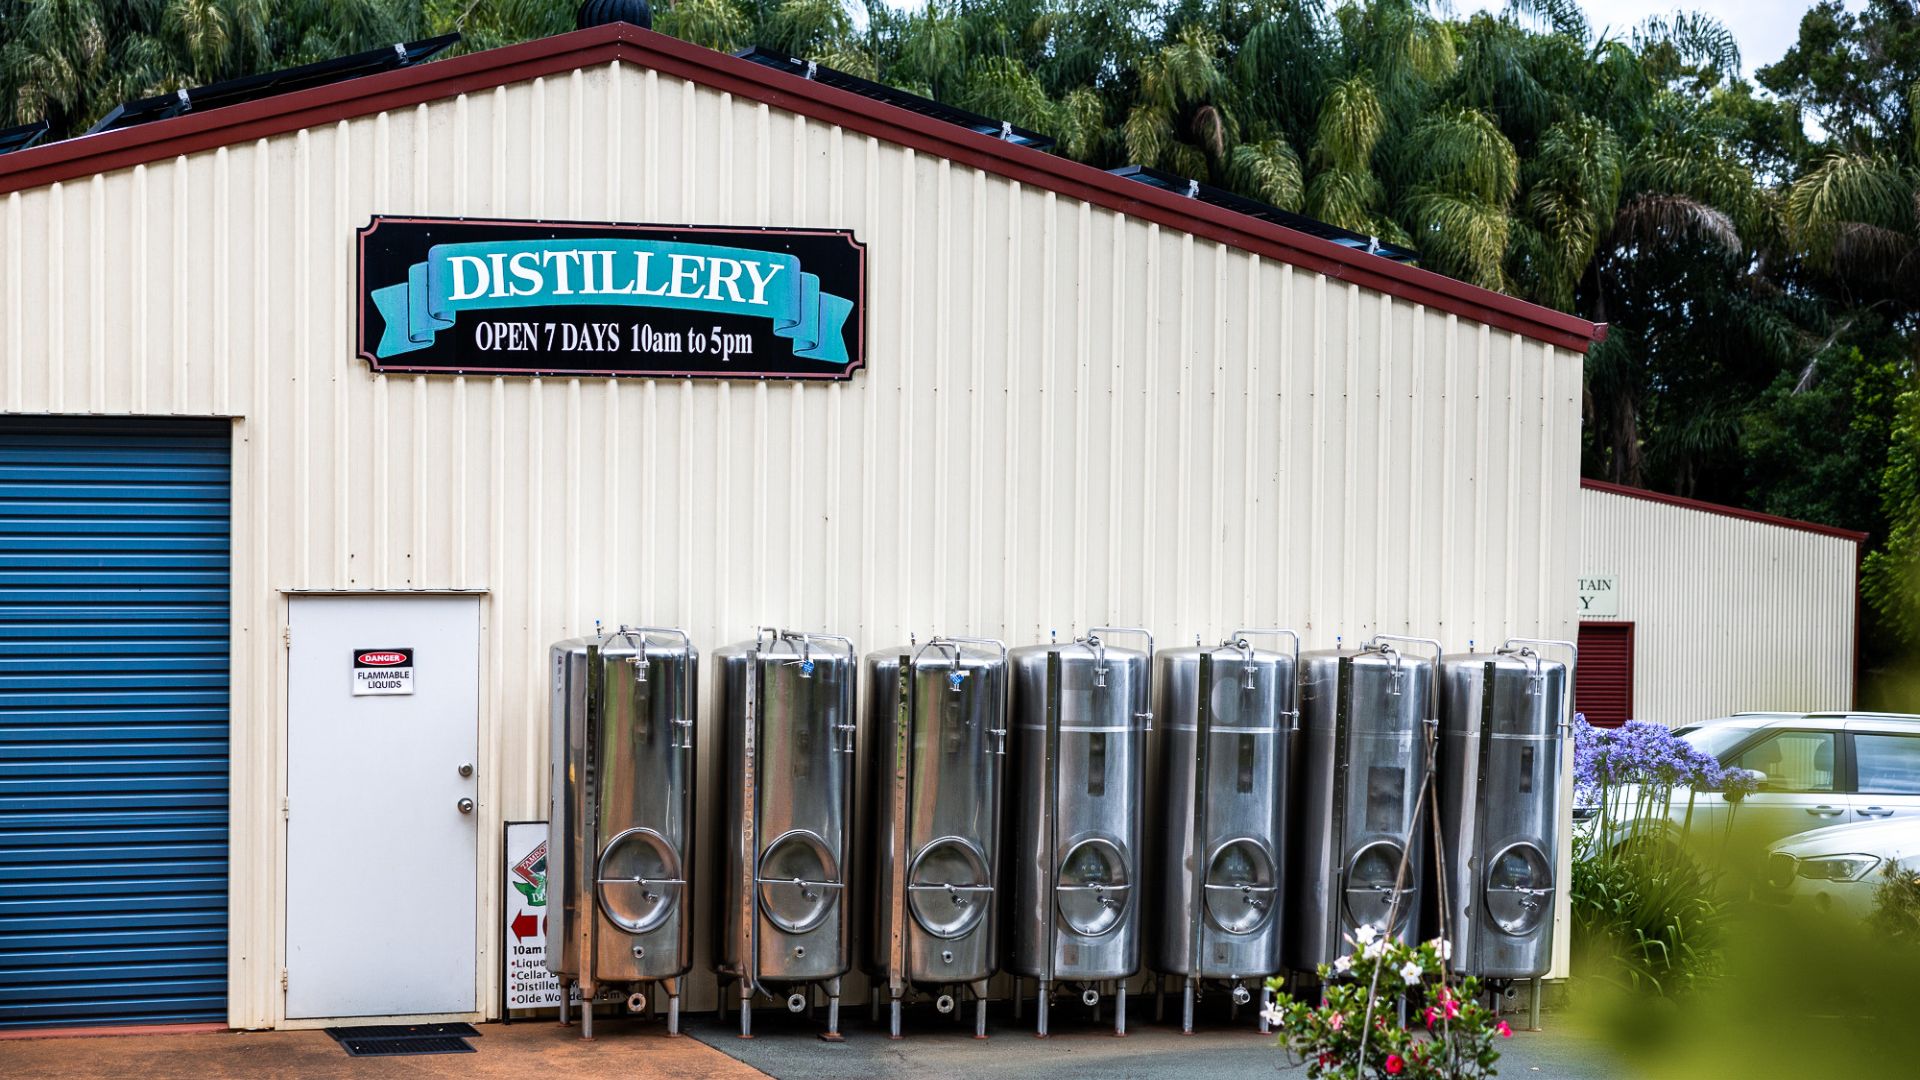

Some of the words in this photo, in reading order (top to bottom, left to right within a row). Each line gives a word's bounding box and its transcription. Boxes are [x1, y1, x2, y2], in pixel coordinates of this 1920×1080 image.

[447, 249, 785, 305] DISTILLERY
[475, 321, 539, 351] OPEN
[544, 322, 556, 352] 7
[561, 322, 620, 352] DAYS
[630, 323, 682, 353] 10am
[687, 326, 706, 354] to
[710, 326, 753, 361] 5pm
[1577, 579, 1612, 591] TAIN
[1580, 596, 1594, 609] Y
[365, 654, 400, 662] DANGER
[357, 671, 410, 680] FLAMMABLE
[368, 680, 402, 689] LIQUIDS
[520, 844, 547, 870] TAMBO
[513, 945, 542, 955] 10am
[516, 959, 546, 969] Lique
[516, 970, 547, 980] Cellar
[516, 981, 560, 992] Distiller
[516, 993, 542, 1004] Olde
